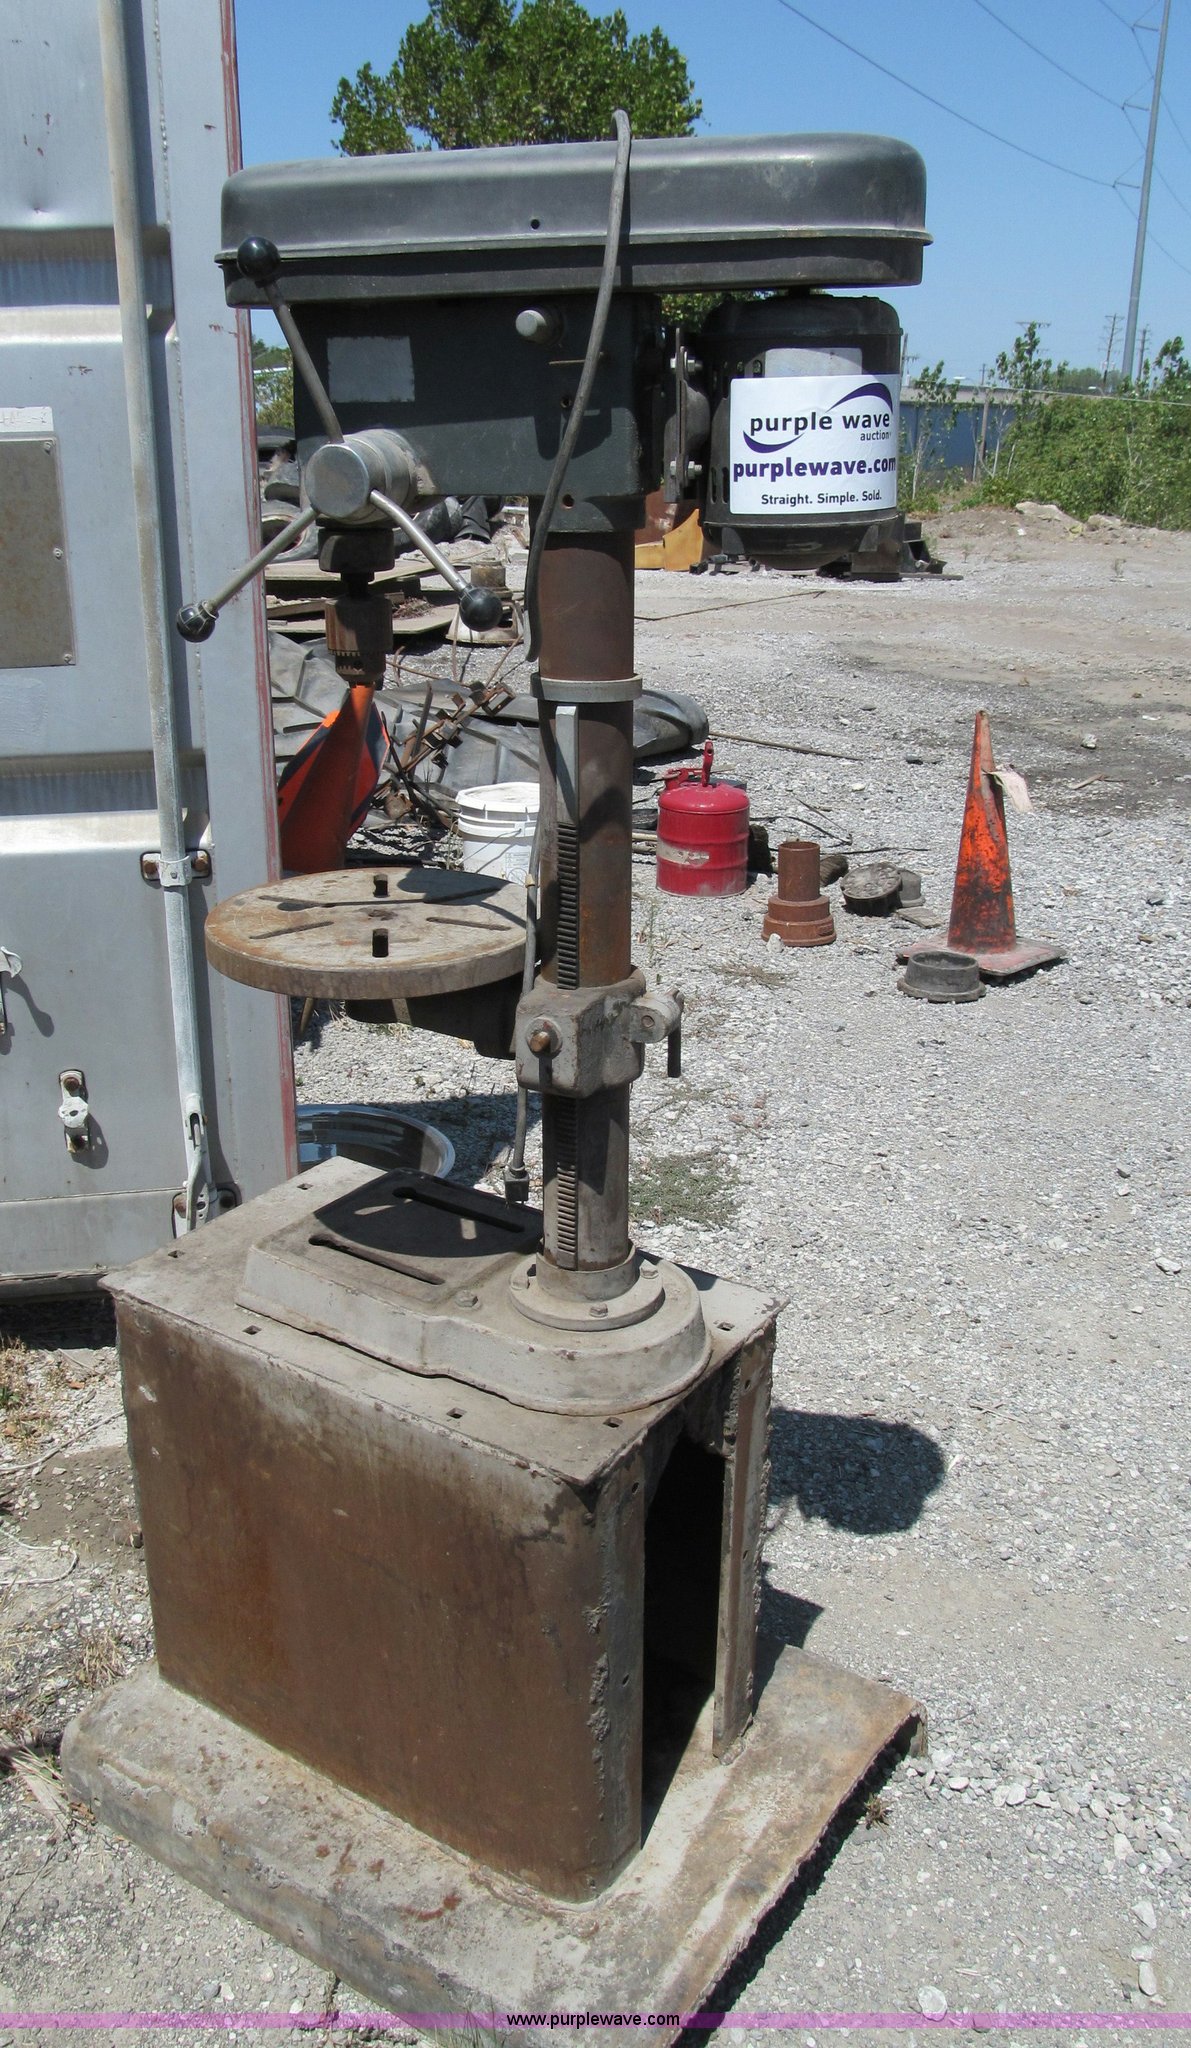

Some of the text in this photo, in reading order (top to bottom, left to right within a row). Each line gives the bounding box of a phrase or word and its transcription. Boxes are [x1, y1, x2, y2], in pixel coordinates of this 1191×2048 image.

[750, 412, 890, 436] purple wave
[860, 431, 889, 442] auction
[733, 457, 896, 482] purplewave.com
[761, 490, 882, 507] Straight. Simple. Sold.
